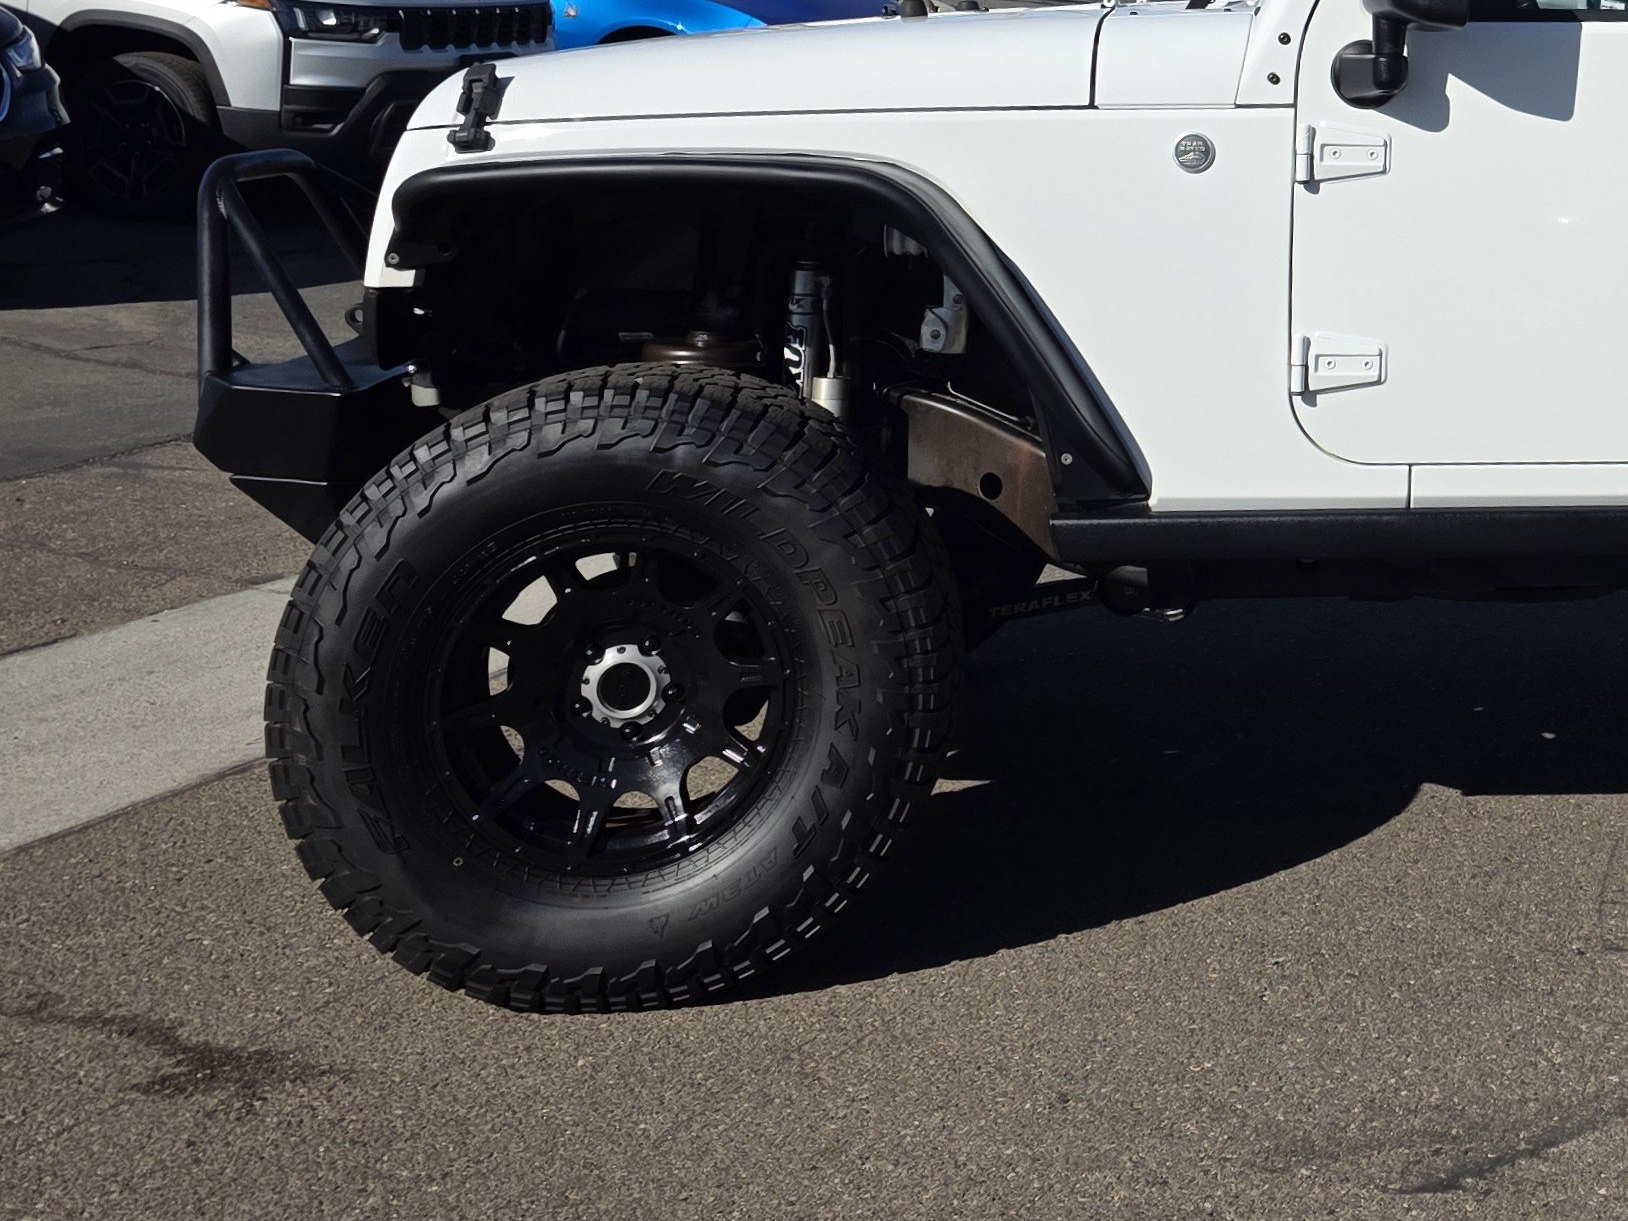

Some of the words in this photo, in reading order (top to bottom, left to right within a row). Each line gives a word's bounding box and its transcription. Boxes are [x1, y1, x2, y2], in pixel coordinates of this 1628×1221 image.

[339, 558, 419, 866] FALKEN
[645, 469, 862, 742] WILDPEAK
[791, 742, 850, 859] A/T
[987, 589, 1093, 619] TERAFLEX
